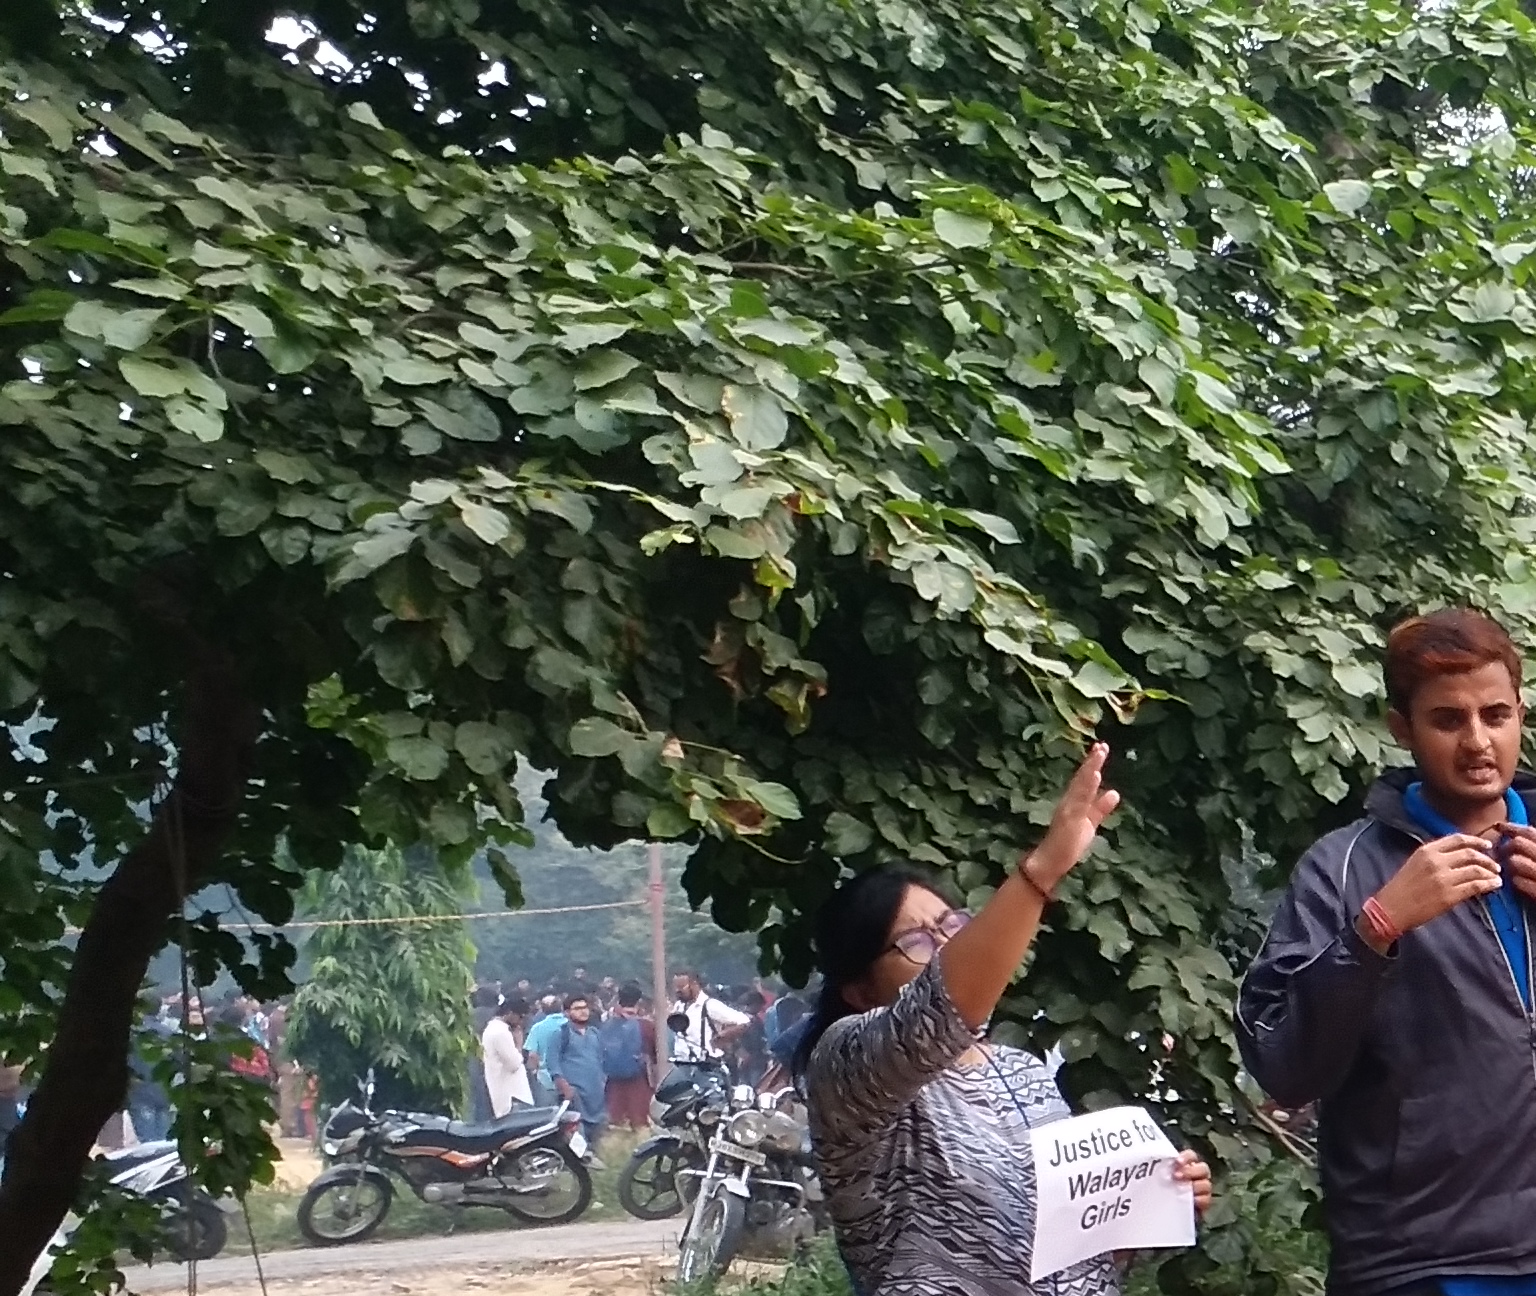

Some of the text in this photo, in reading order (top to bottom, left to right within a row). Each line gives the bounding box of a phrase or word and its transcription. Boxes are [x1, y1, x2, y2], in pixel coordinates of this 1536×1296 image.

[1049, 1127, 1133, 1167] Justice
[1068, 1158, 1162, 1201] Walayar
[1080, 1196, 1132, 1230] Girls
